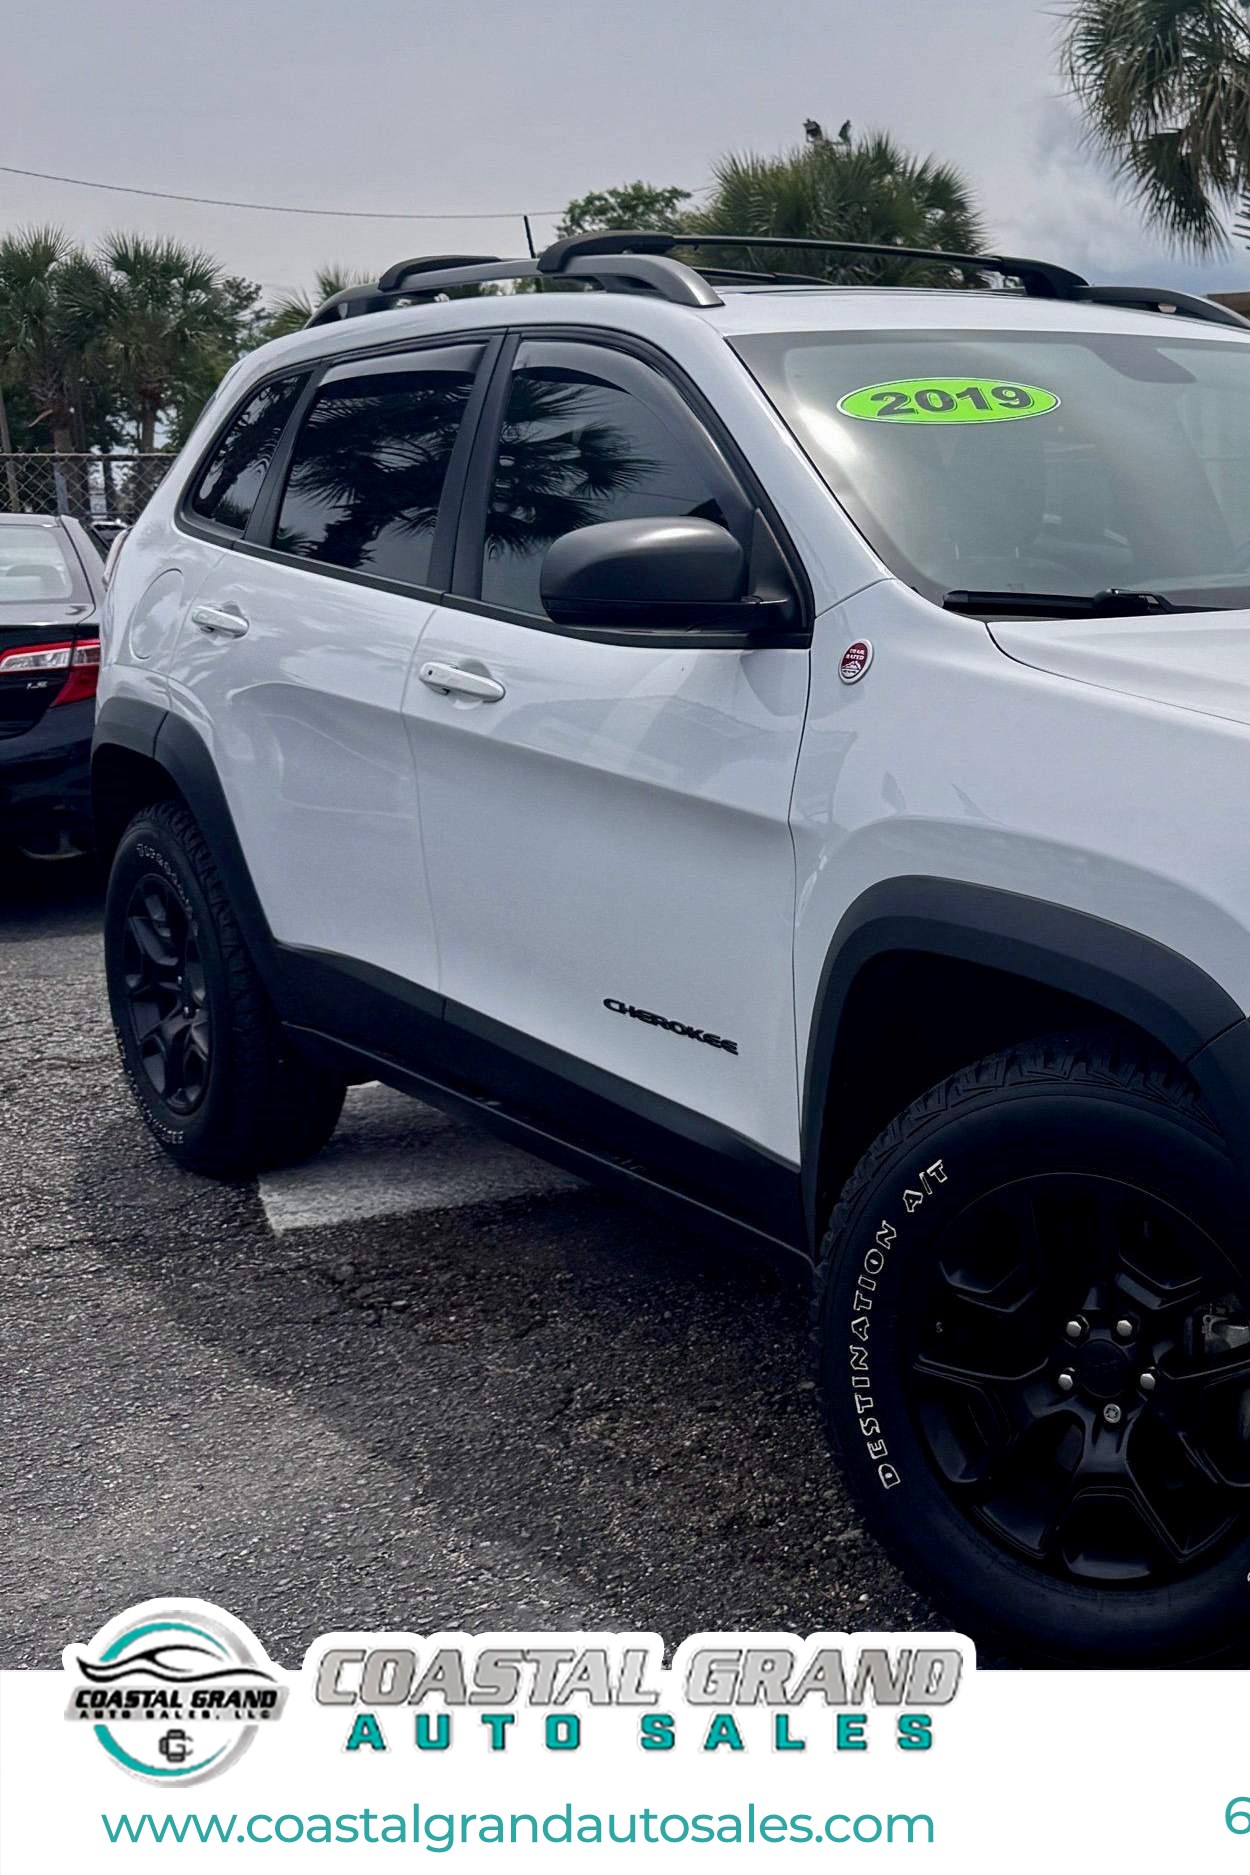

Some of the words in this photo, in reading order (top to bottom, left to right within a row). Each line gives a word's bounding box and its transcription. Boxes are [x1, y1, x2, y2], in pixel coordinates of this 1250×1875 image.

[869, 386, 1034, 417] 2019
[603, 998, 739, 1056] CHEROKEE
[849, 1219, 901, 1490] DESTINATION
[902, 1159, 949, 1213] A/T
